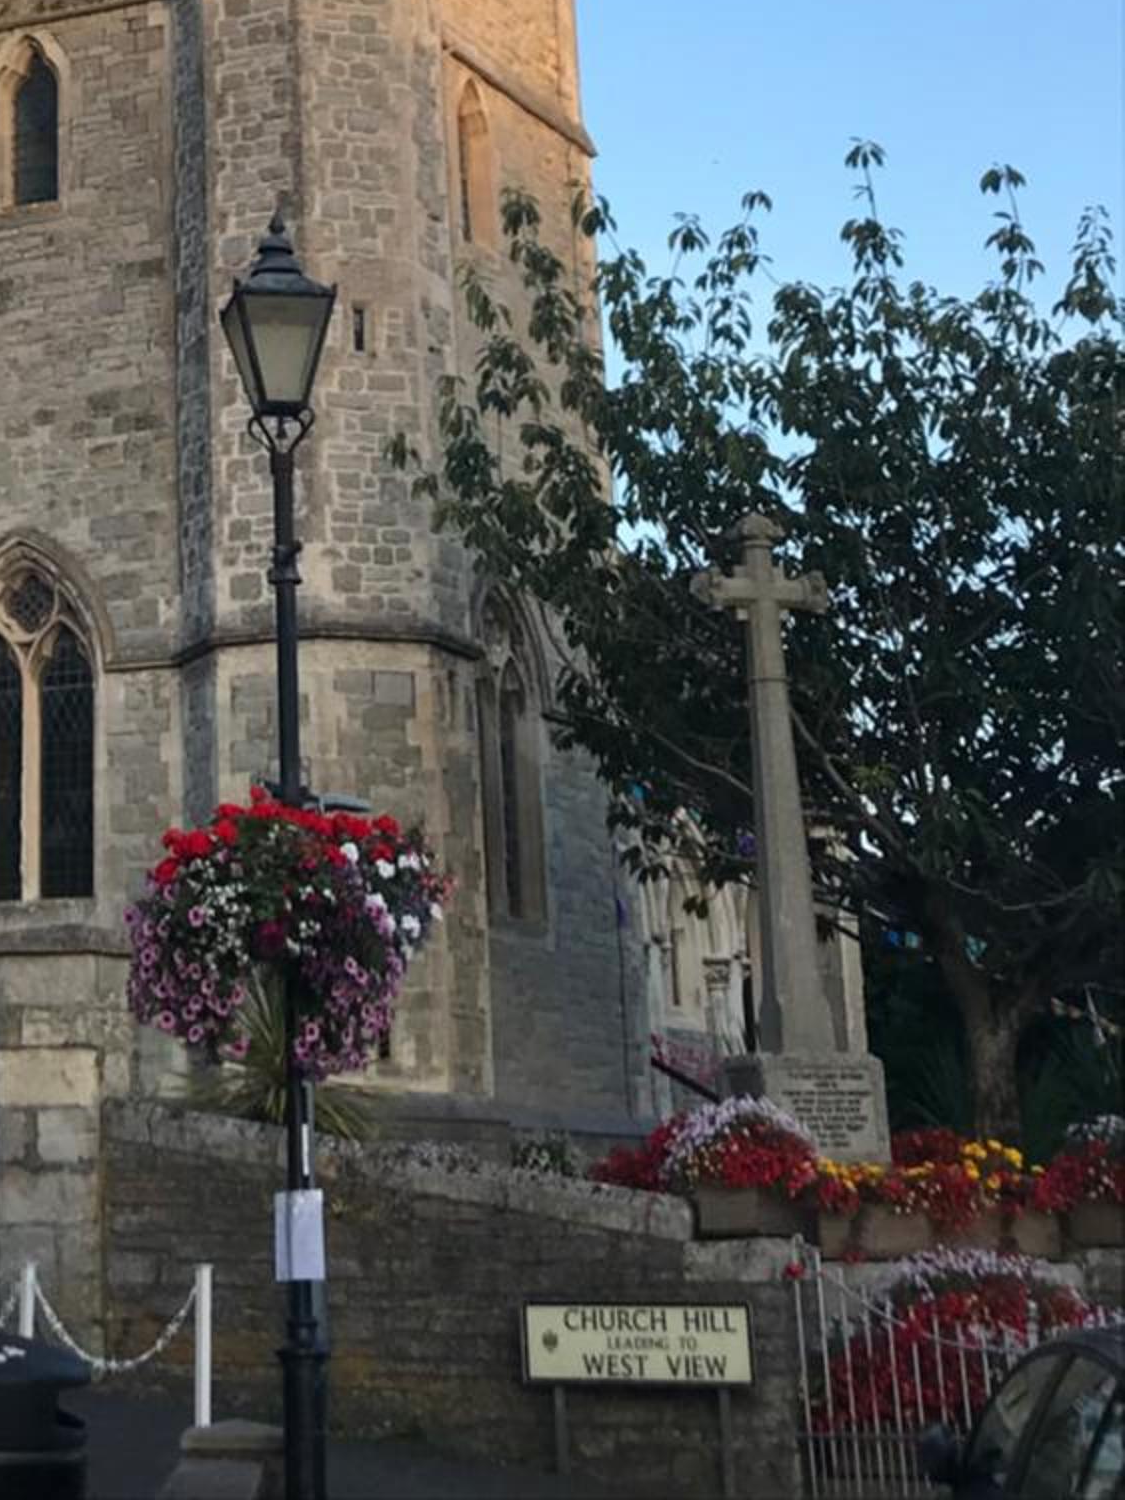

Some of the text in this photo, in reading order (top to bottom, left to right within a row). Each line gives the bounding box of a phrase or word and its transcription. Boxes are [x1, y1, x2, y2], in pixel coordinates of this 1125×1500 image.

[564, 1308, 737, 1333] CHURCH HILL
[607, 1336, 698, 1350] LEADING TO
[583, 1354, 727, 1378] WEST VIEW
